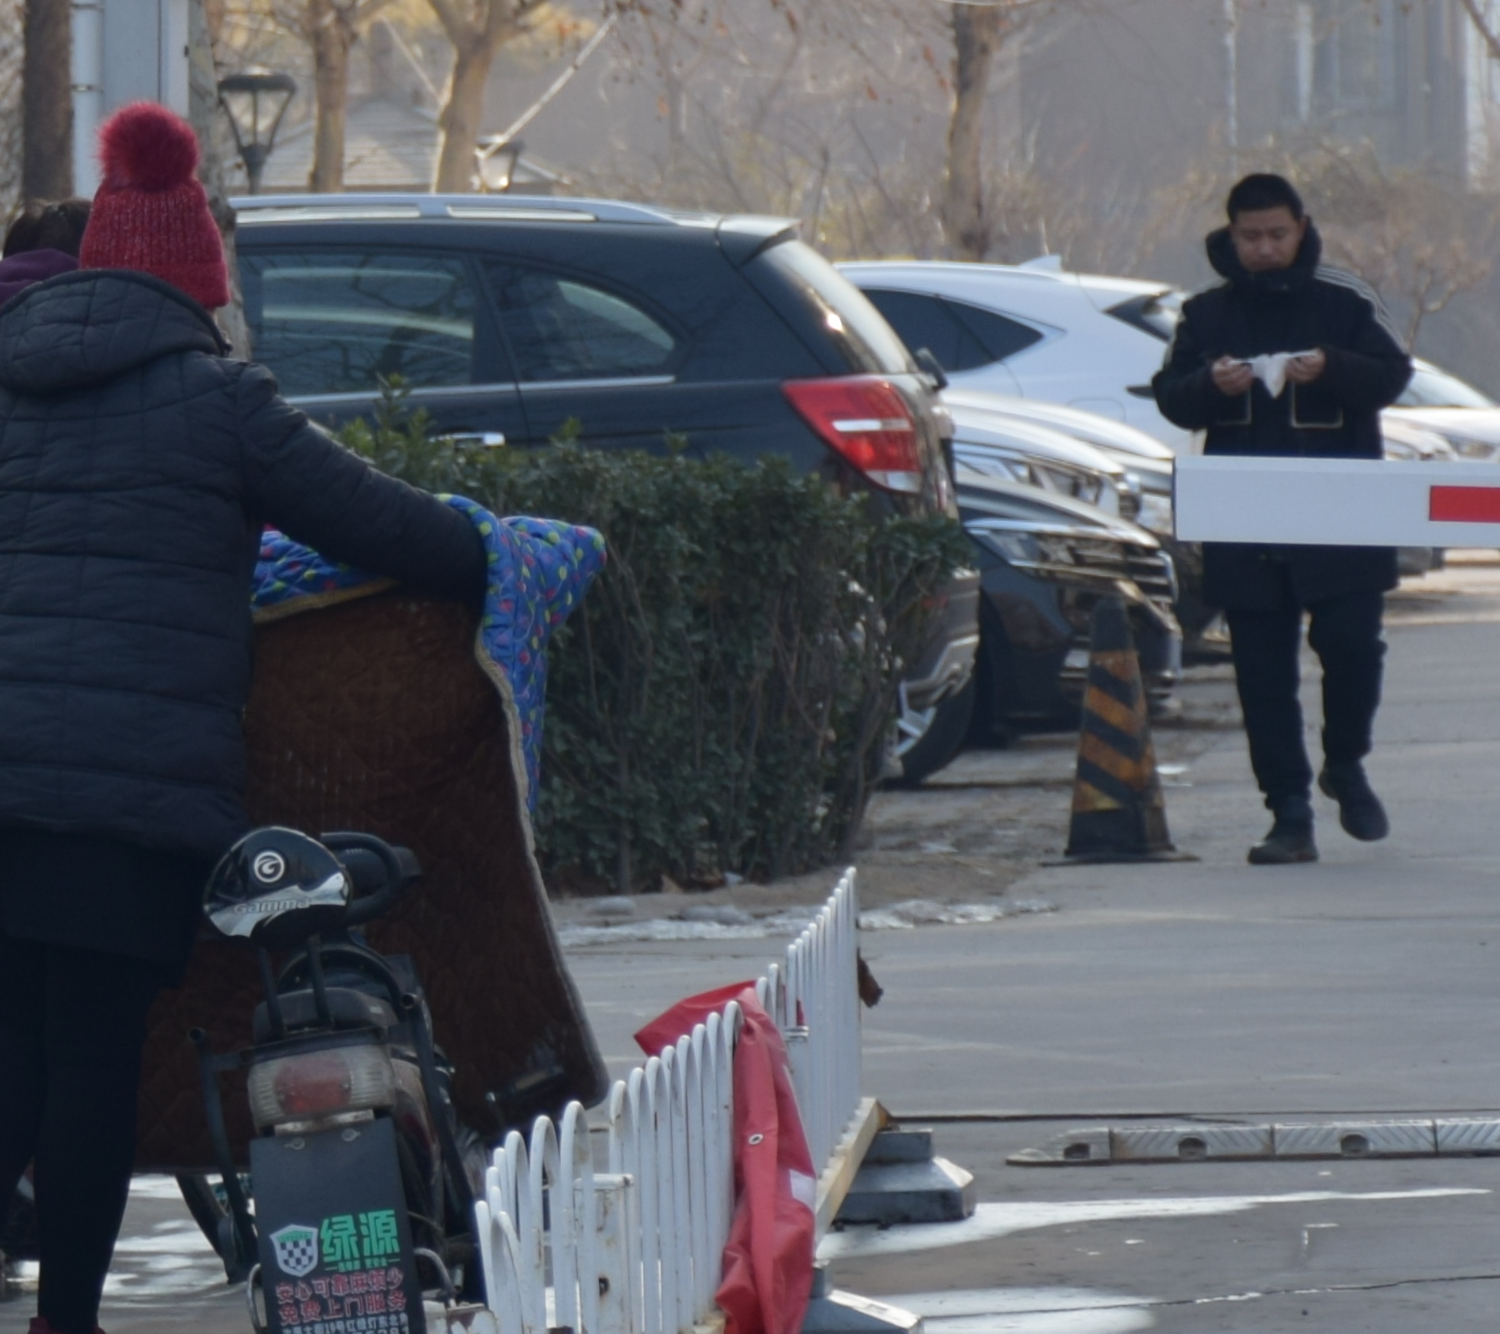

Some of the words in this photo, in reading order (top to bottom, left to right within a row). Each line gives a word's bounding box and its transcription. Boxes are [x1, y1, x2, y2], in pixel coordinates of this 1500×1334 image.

[320, 1209, 400, 1263] 绿源
[275, 1267, 404, 1305] 安心可靠麻烦少
[278, 1290, 407, 1326] 免费上门服务
